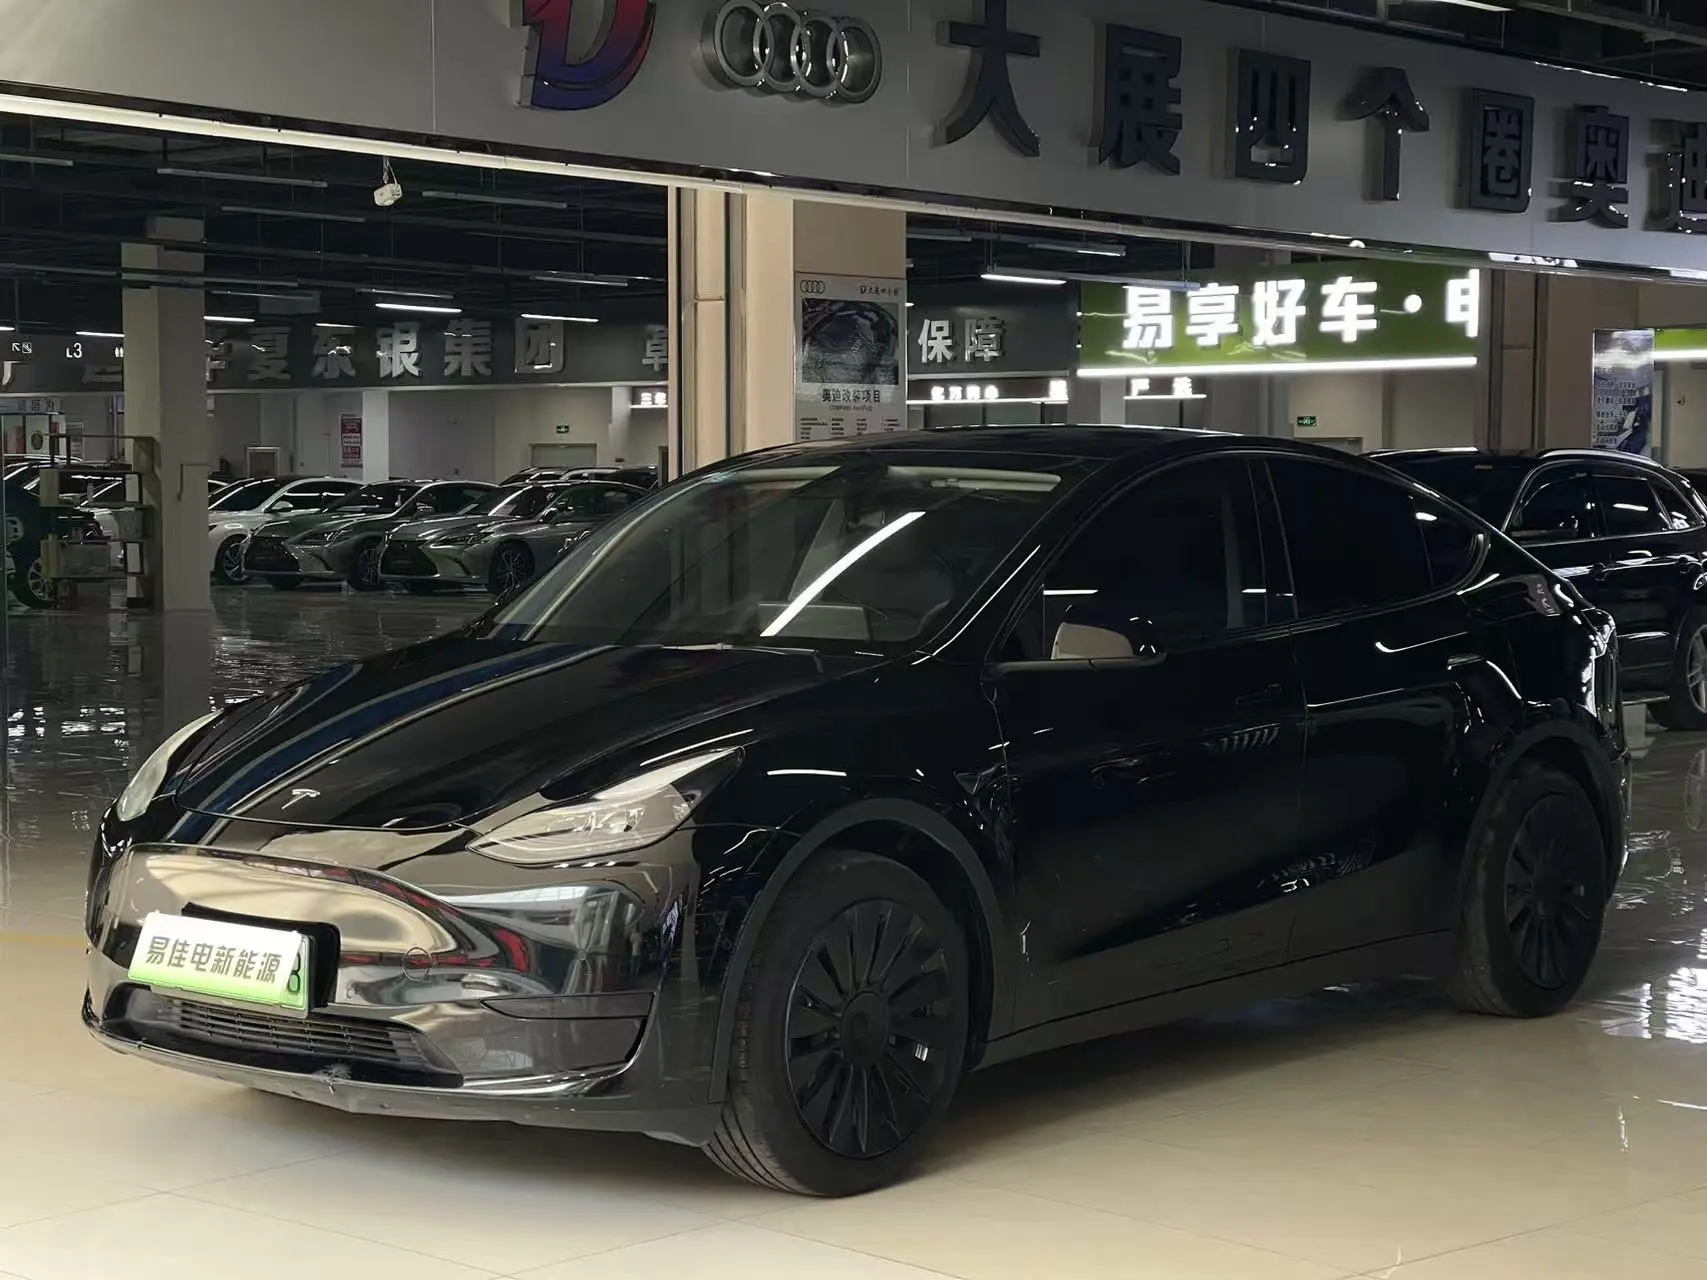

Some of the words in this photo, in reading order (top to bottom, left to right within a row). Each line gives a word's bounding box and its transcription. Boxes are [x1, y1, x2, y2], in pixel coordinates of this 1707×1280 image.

[66, 343, 82, 358] L3
[917, 317, 1003, 363] 保障
[146, 935, 283, 984] 易佳电新能源
